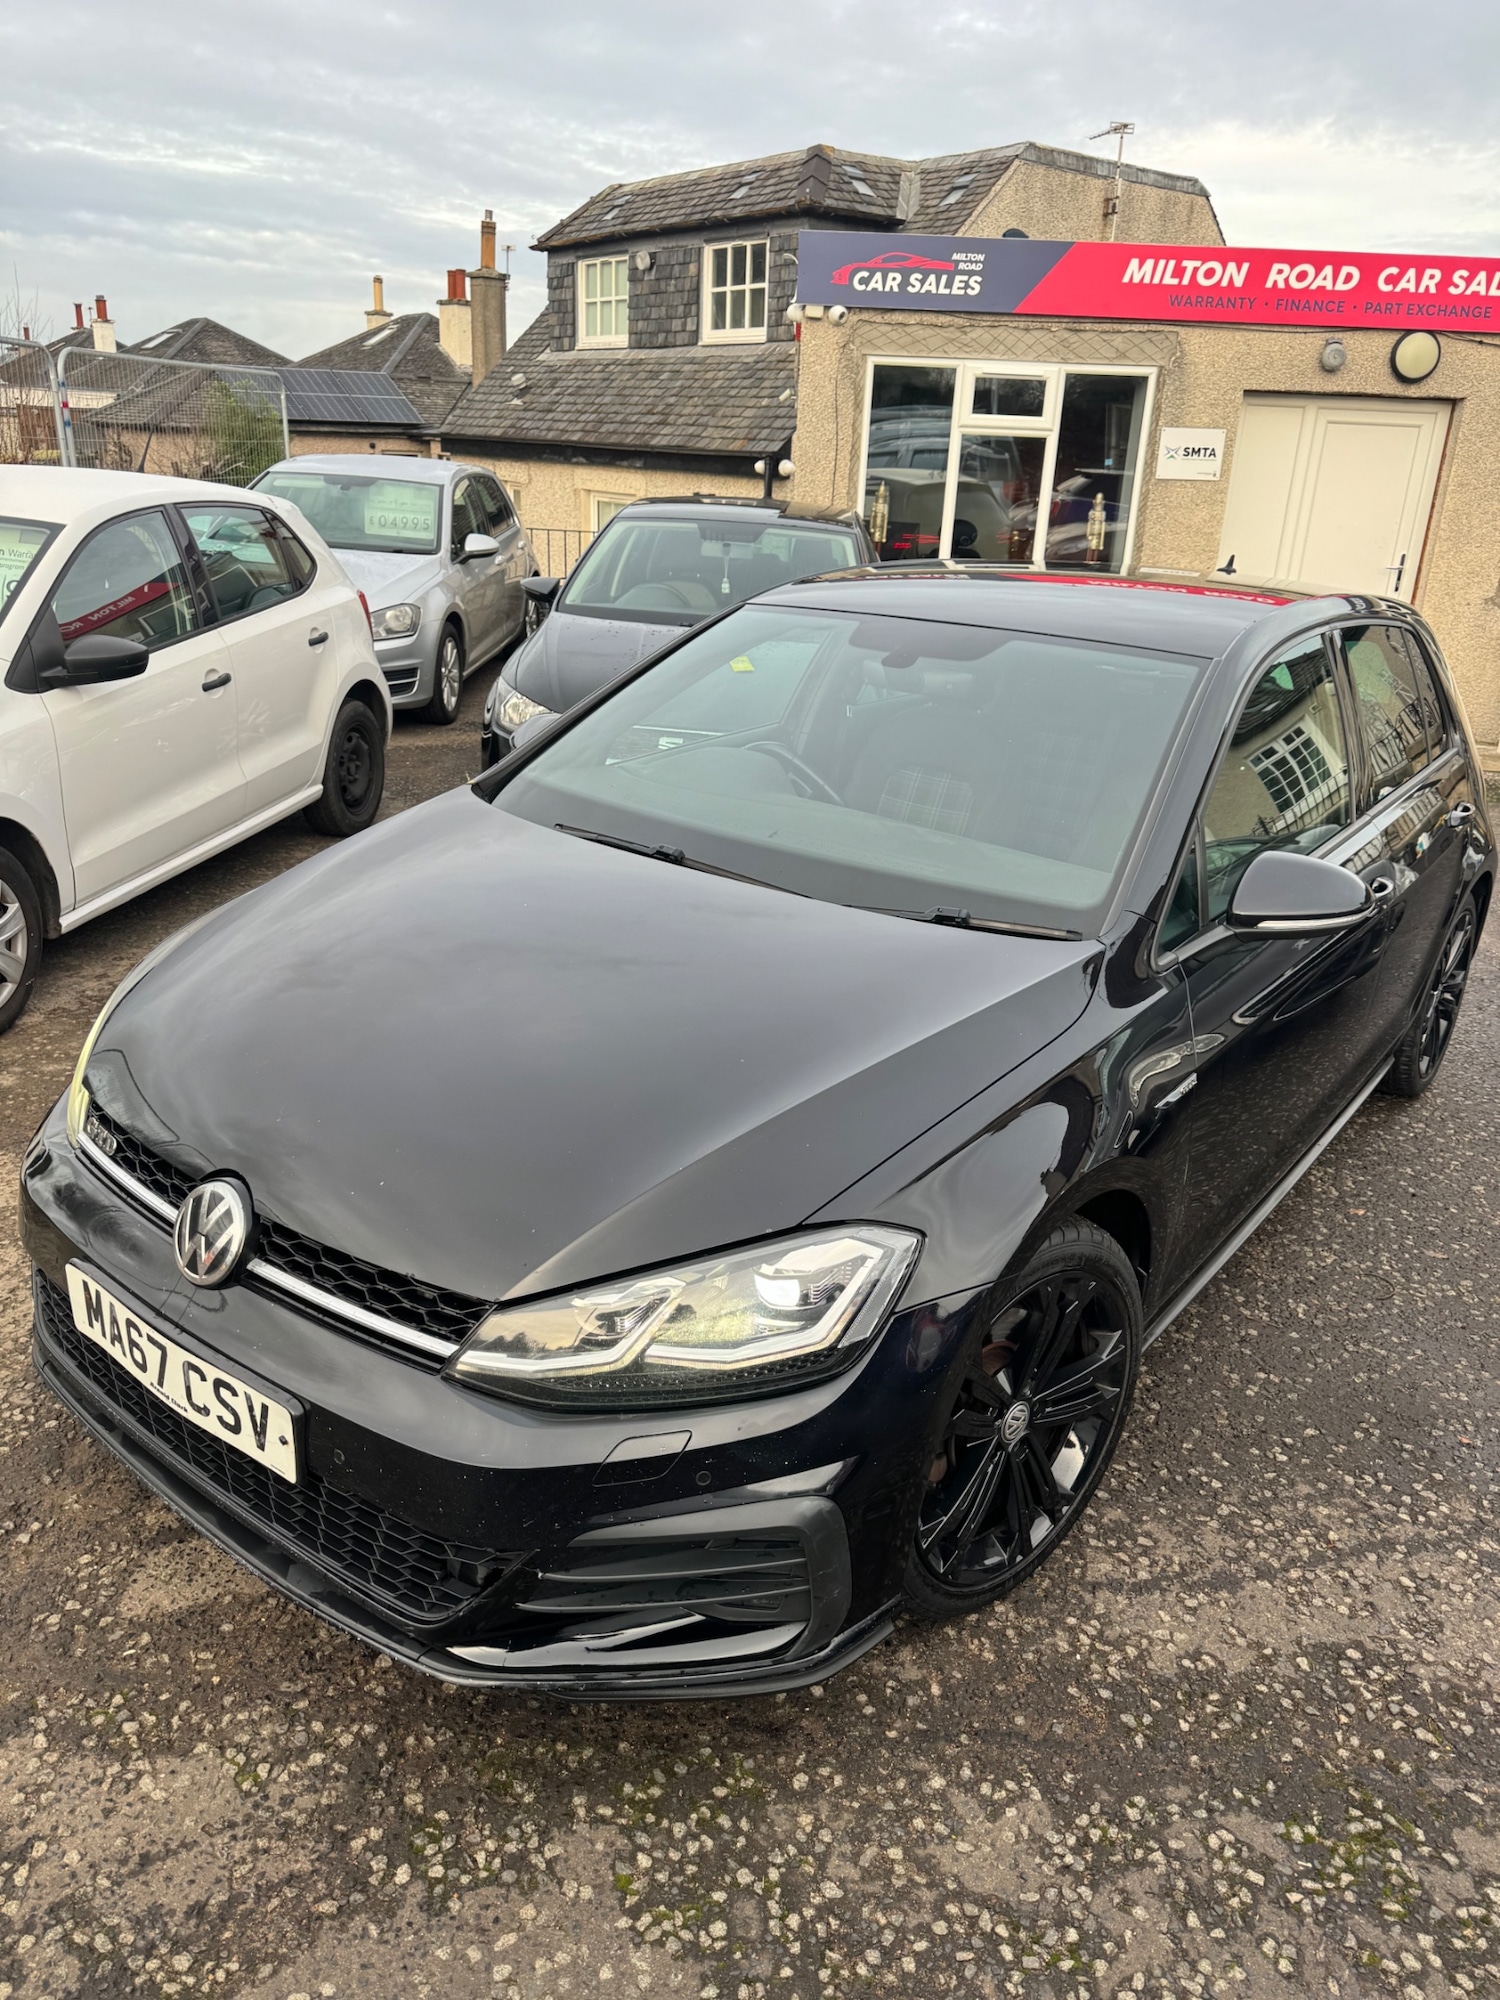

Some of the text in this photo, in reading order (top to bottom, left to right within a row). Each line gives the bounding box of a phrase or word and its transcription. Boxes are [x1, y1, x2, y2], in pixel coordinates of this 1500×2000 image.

[951, 252, 986, 262] MILTON
[957, 262, 983, 271] ROAD
[852, 271, 983, 296] CAR SALES
[1121, 258, 1250, 288] MILTON
[1264, 263, 1361, 291] ROAD
[1377, 266, 1442, 294] CAR
[1169, 294, 1492, 319] WARRANTY FINANCE PART EXCHANGE
[1182, 446, 1217, 458] SMTA
[82, 1279, 269, 1452] MA67 CSV
